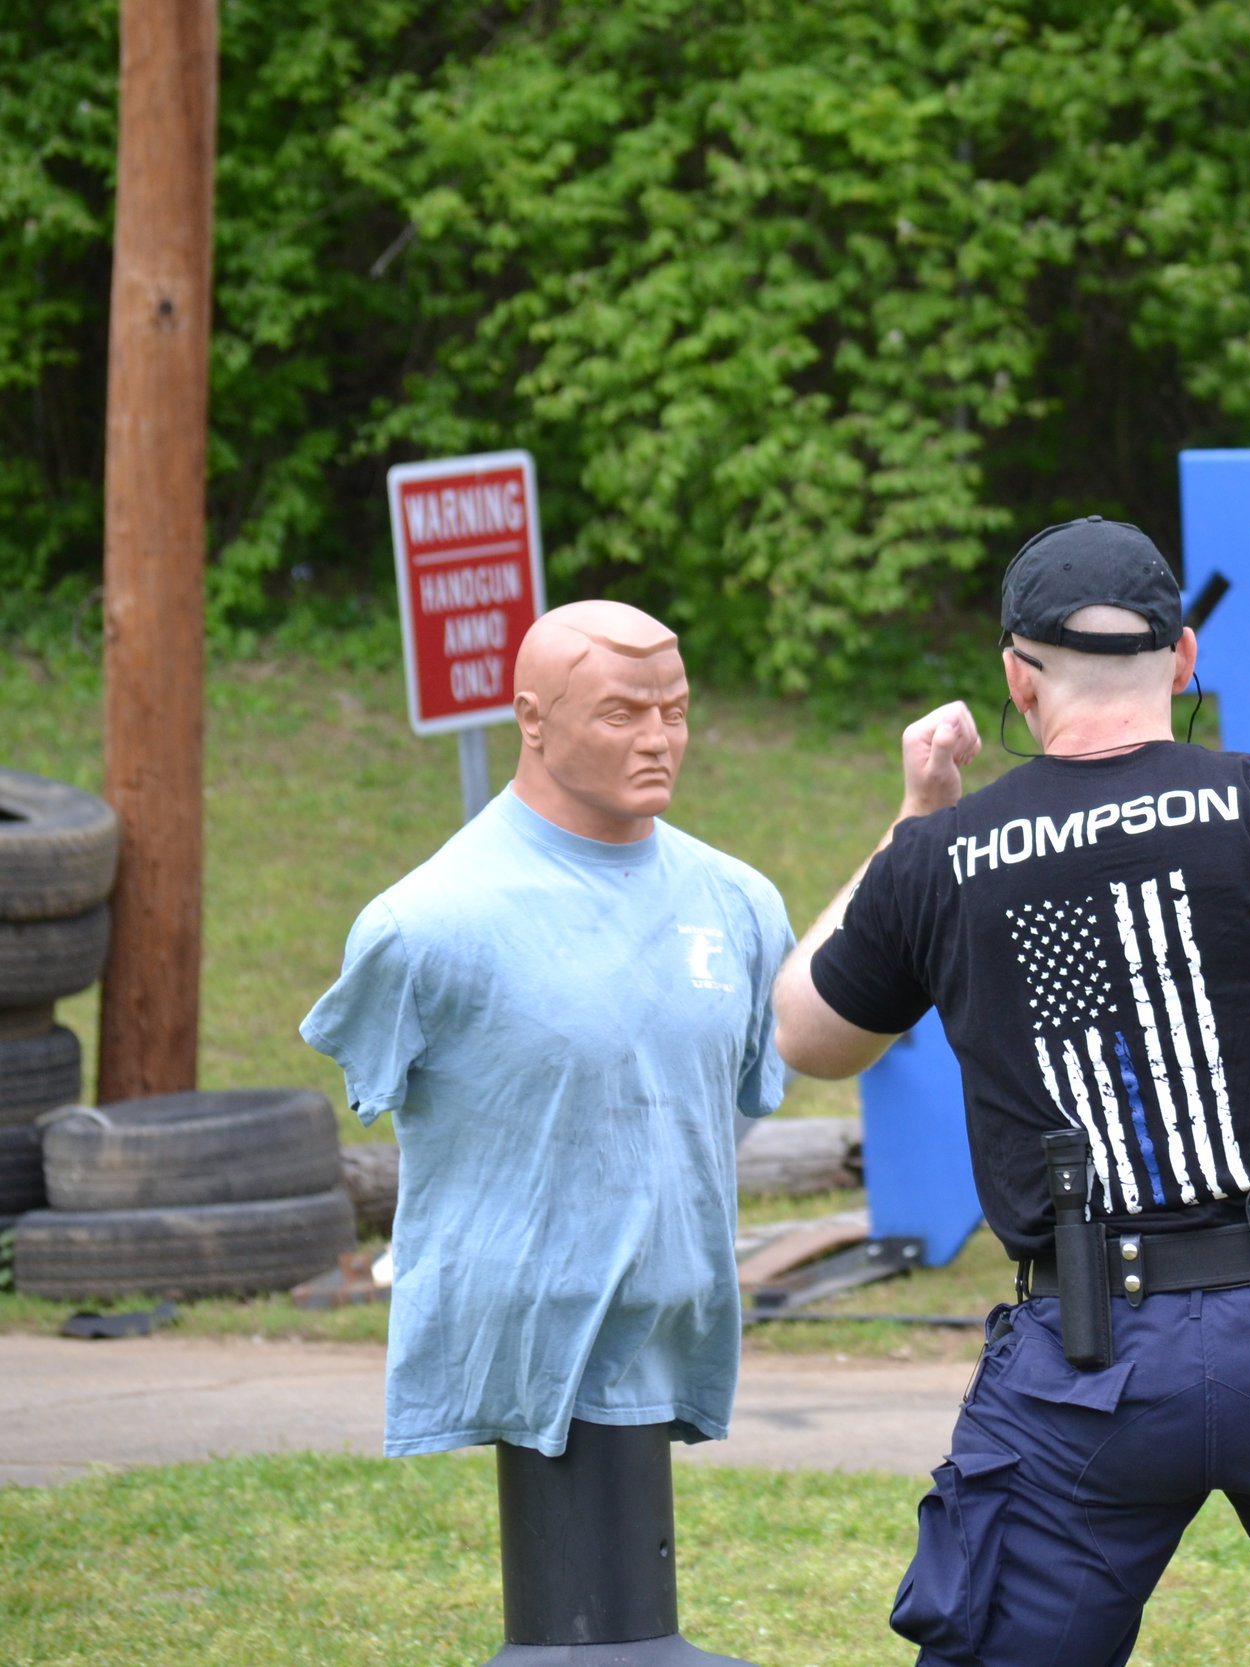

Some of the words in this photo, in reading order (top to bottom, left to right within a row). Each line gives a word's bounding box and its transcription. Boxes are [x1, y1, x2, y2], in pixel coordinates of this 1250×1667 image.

[405, 481, 523, 543] WARNING
[421, 563, 520, 613] HANDGUN
[445, 610, 505, 656] AMMO
[452, 656, 503, 701] ONLY
[948, 785, 1240, 885] THOMPSON
